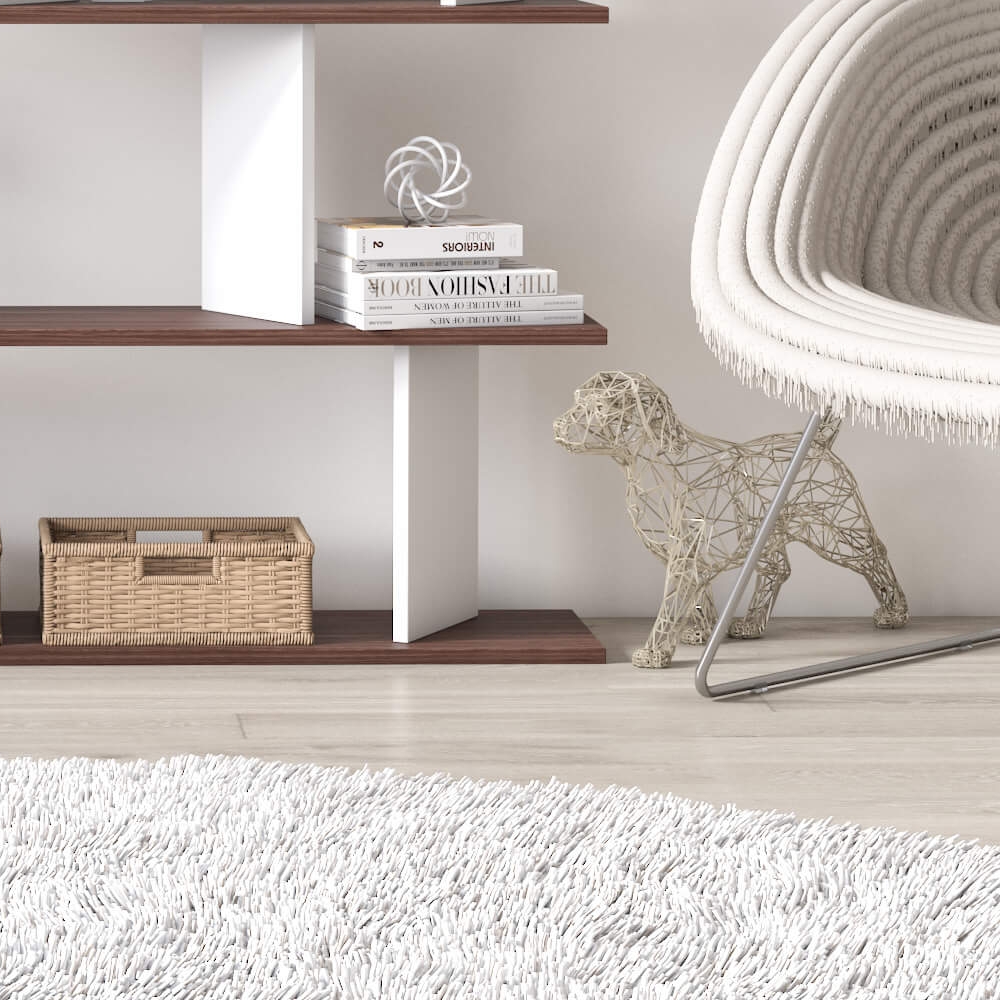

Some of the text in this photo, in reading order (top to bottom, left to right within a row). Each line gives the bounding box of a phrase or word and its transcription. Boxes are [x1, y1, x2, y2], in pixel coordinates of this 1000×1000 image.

[373, 240, 384, 249] 2
[442, 242, 495, 253] INTERIORS
[367, 274, 556, 298] THE FASHION BOOK
[413, 300, 521, 311] THE ALLURE OF WOMEN
[429, 315, 521, 325] THE ALLURE OF MEN
